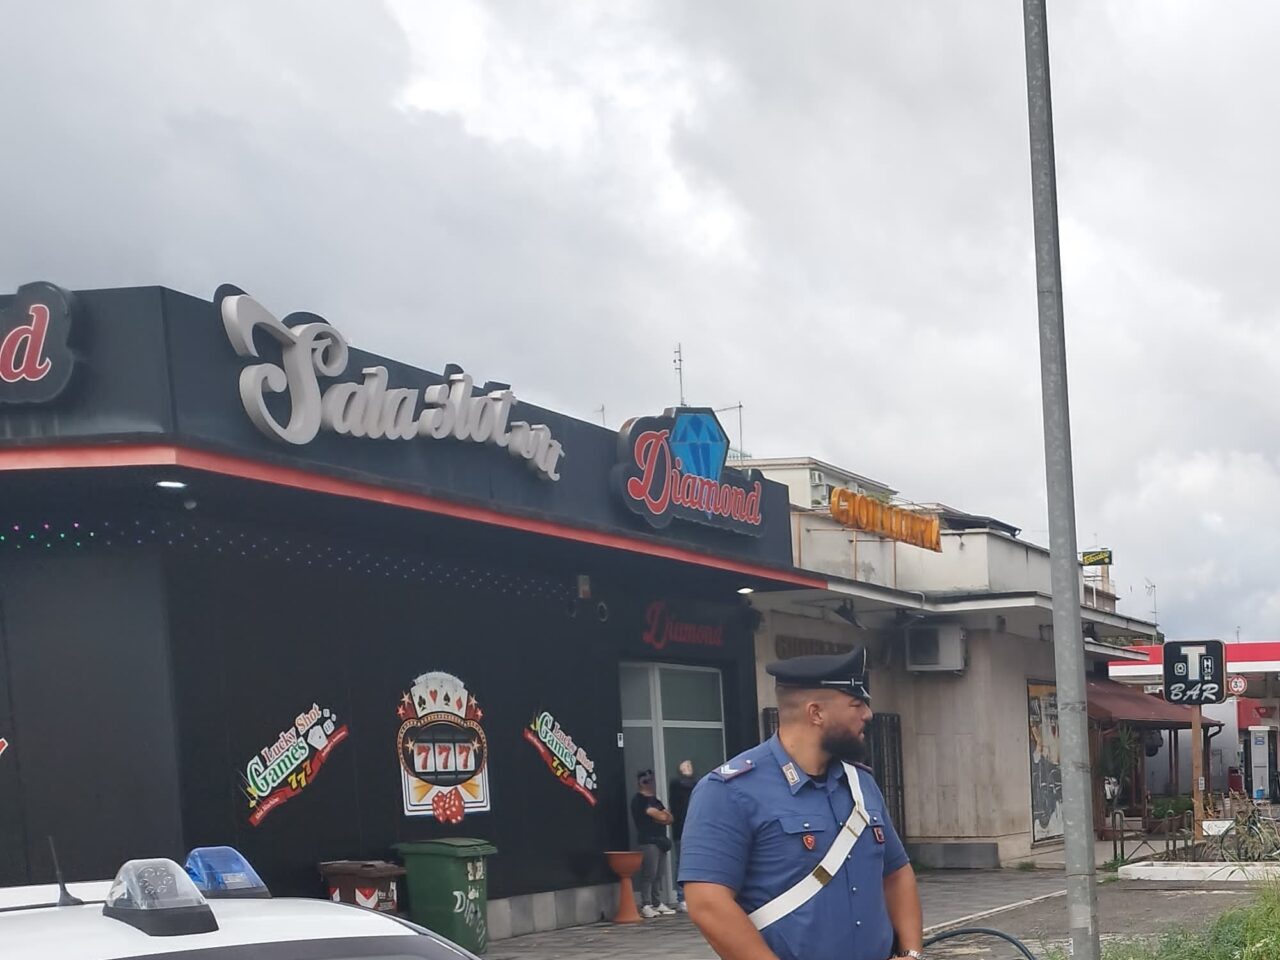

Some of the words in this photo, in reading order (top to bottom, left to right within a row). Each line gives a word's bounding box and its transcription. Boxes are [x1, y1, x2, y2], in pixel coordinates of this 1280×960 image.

[627, 429, 762, 526] Diamond
[643, 601, 724, 650] Diamond
[1169, 683, 1219, 701] BAR
[261, 727, 297, 765] Lucky
[295, 703, 321, 735] Shot
[538, 711, 576, 771] Games
[247, 737, 309, 797] Games
